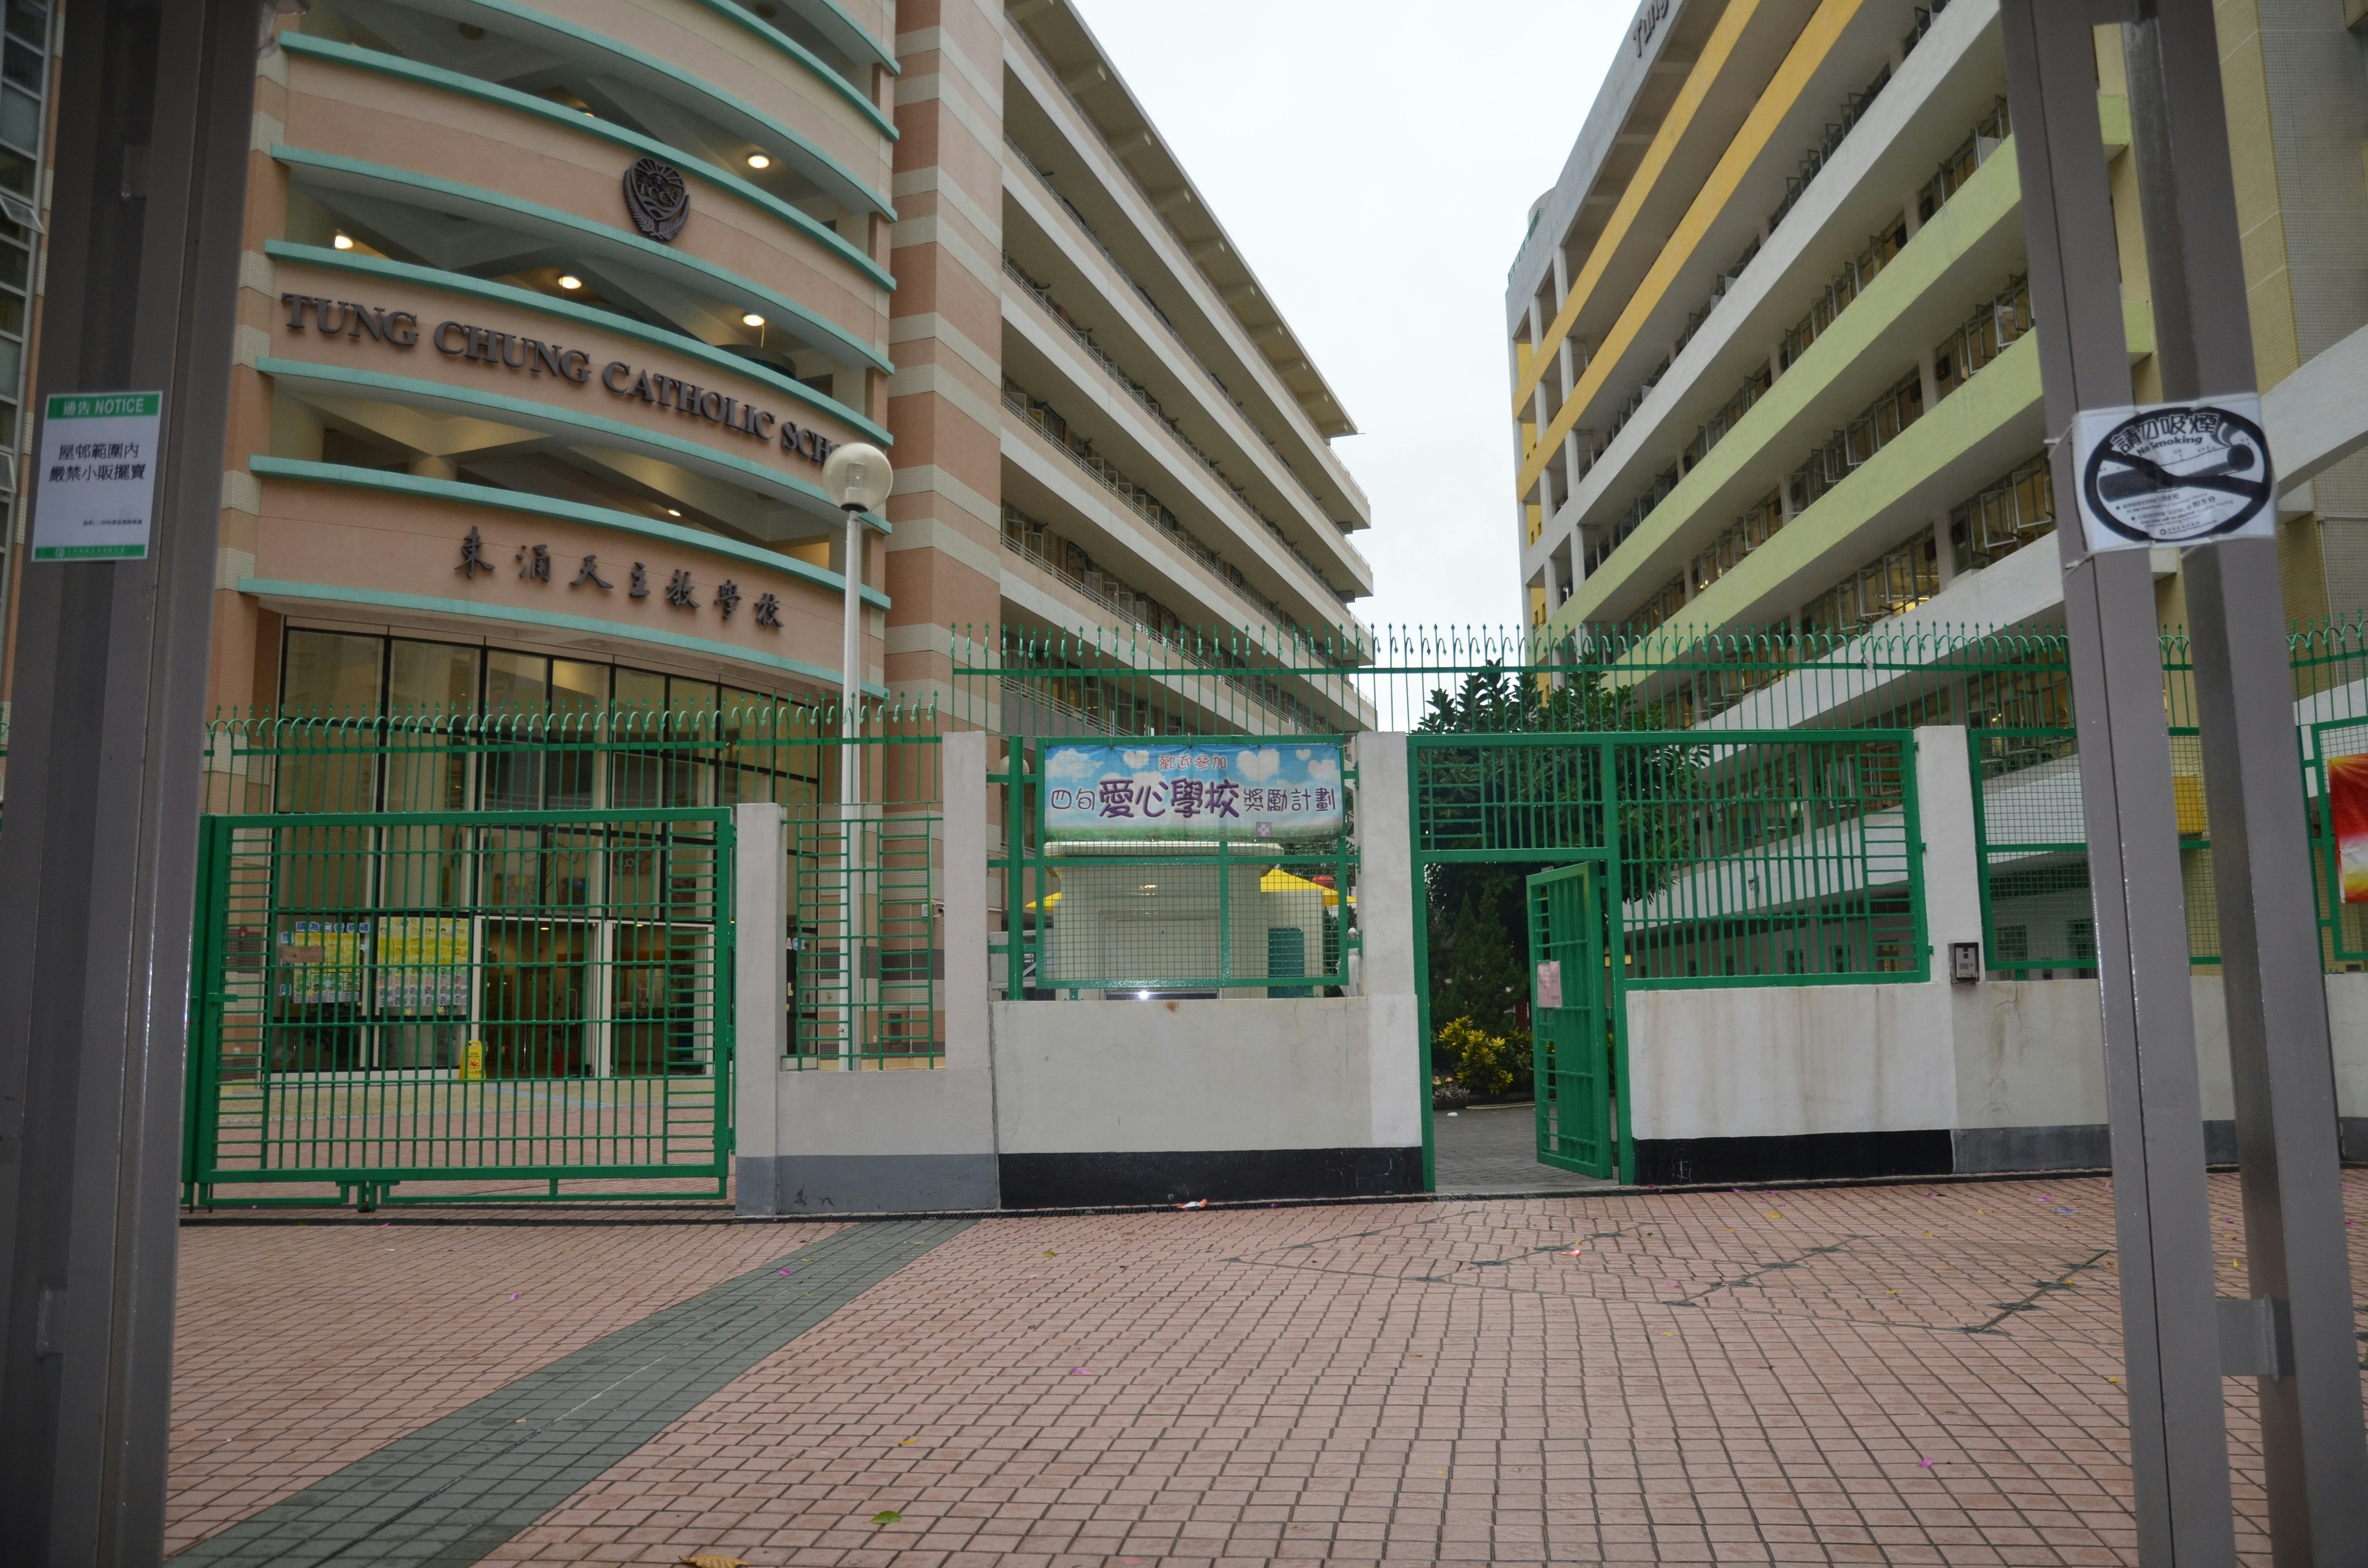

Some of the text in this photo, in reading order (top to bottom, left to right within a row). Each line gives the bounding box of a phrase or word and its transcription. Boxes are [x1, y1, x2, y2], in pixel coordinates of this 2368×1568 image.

[281, 292, 842, 465] TUNG CHUNG CATHOLIC SCH
[63, 398, 144, 416] 通告 NOTICE
[2110, 414, 2219, 454] 請勿吸煙
[59, 442, 138, 460] 屋邨範圍內
[2136, 436, 2203, 456] No Smoking
[49, 464, 146, 482] 嚴禁小販擺賣
[454, 525, 785, 628] 東涌天主教學校
[1159, 754, 1227, 770] 歡迎參加
